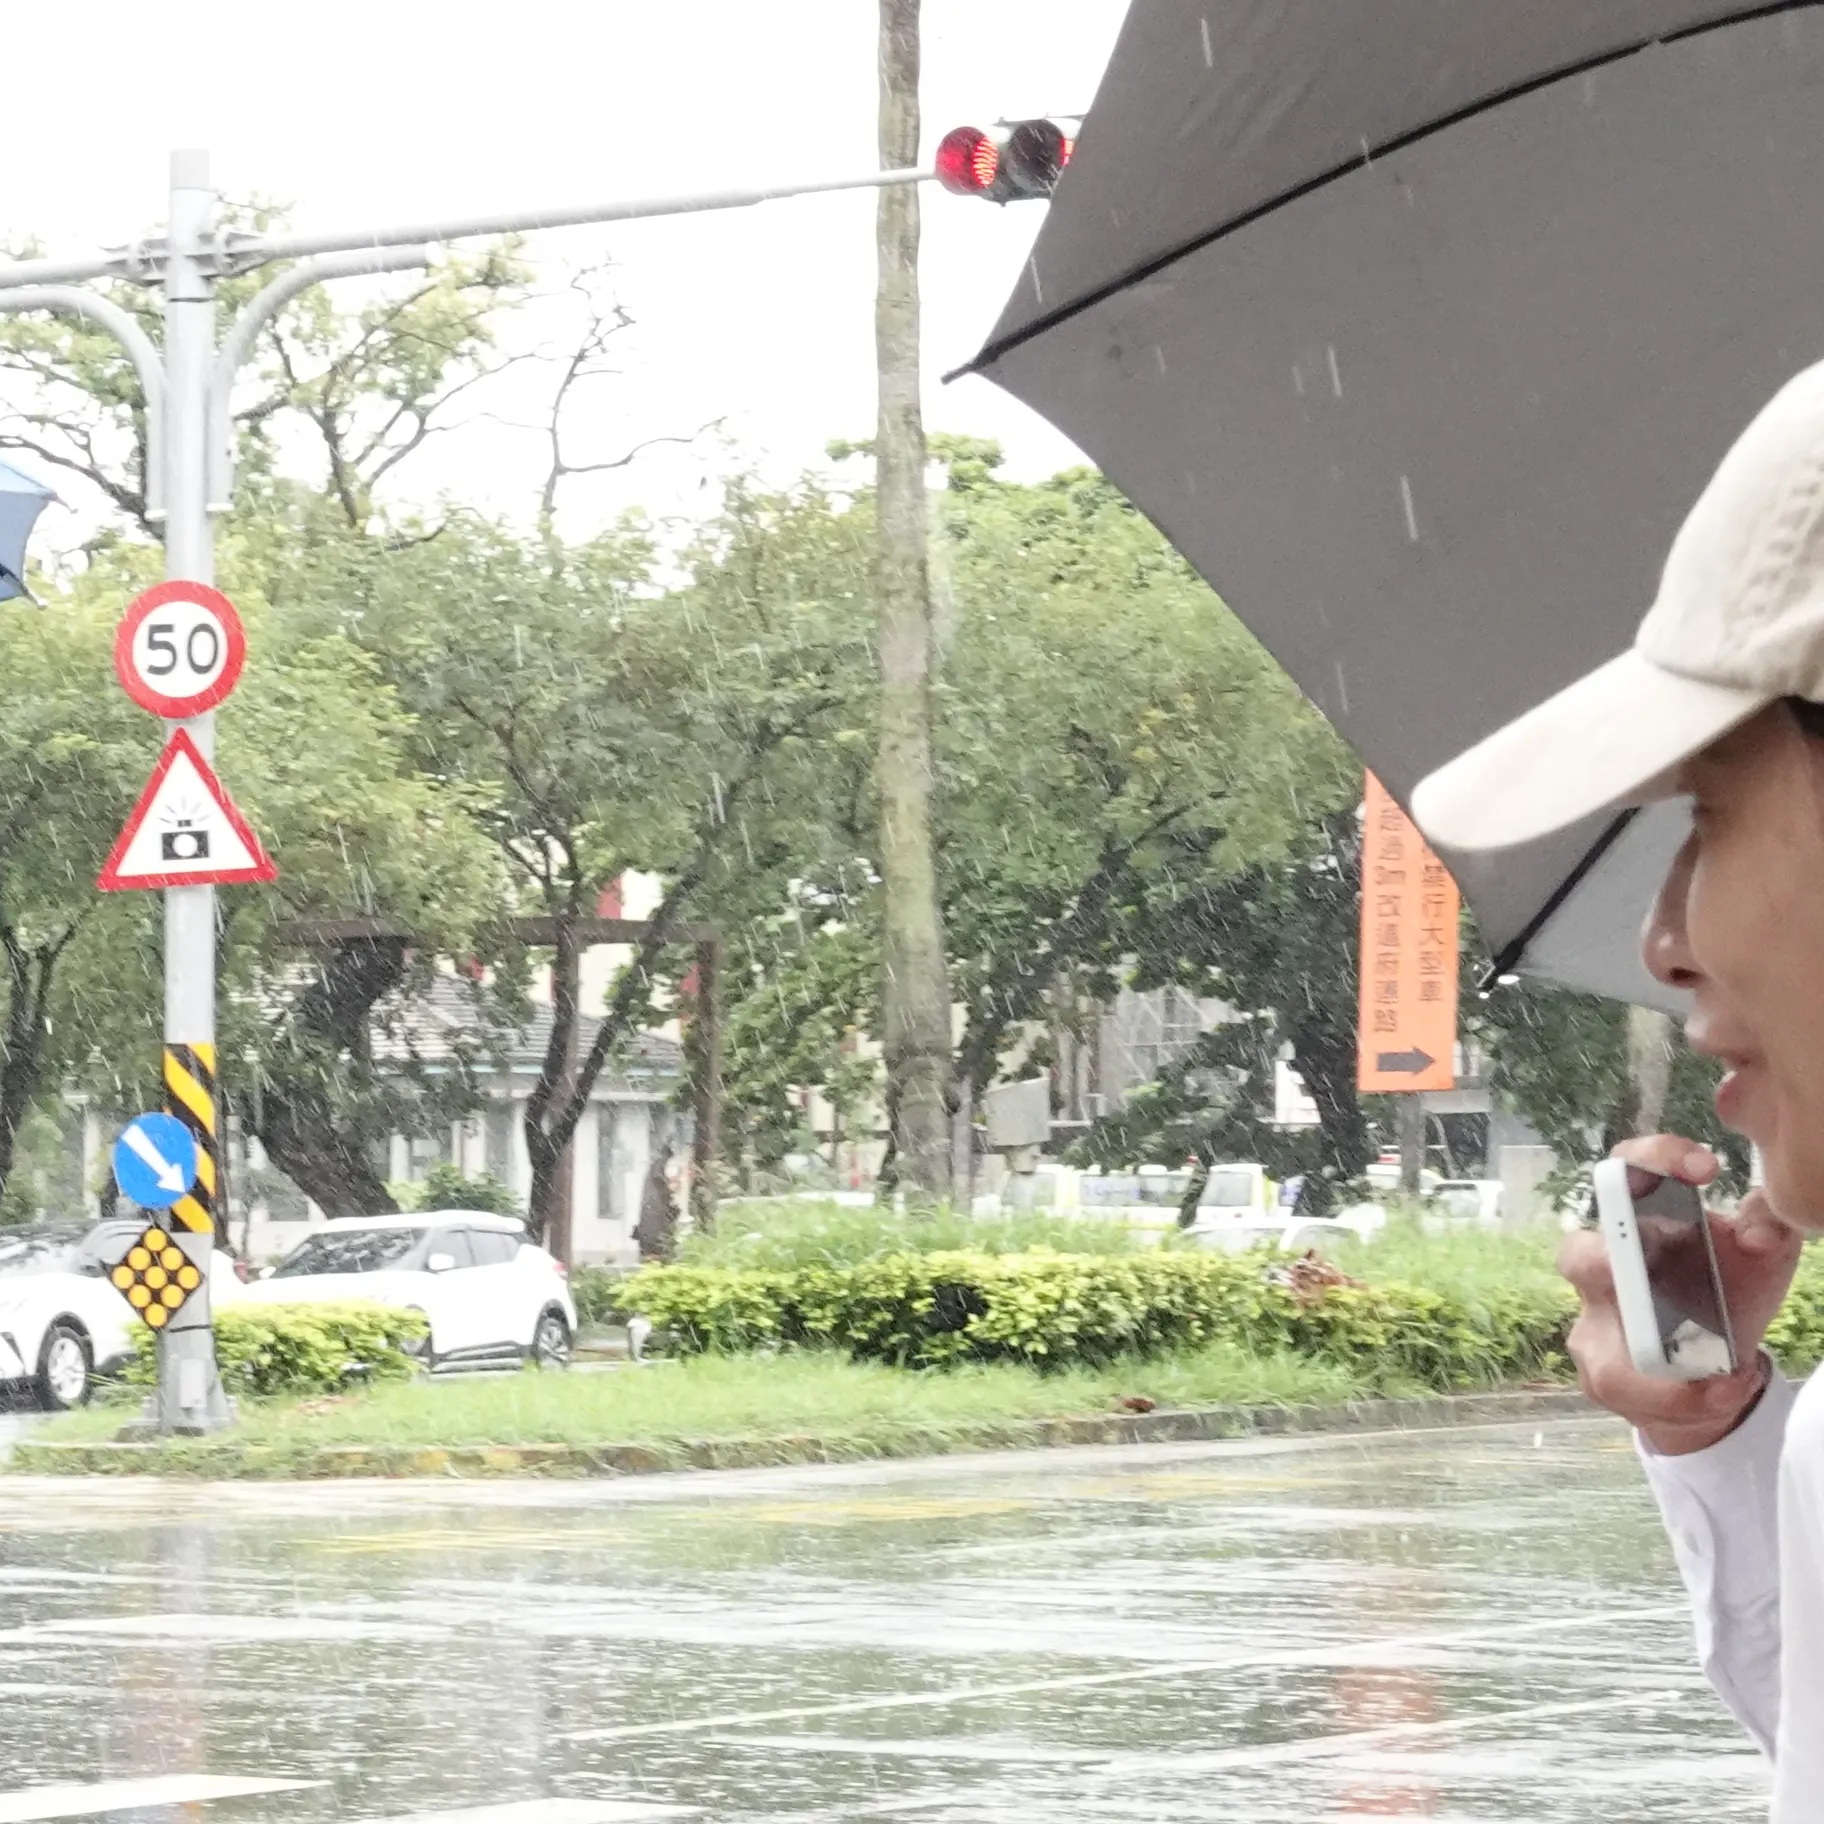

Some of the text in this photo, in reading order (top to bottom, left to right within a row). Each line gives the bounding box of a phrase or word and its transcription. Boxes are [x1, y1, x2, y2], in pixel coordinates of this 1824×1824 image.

[146, 622, 219, 676] 50
[1417, 844, 1447, 1003] 禁行大型車
